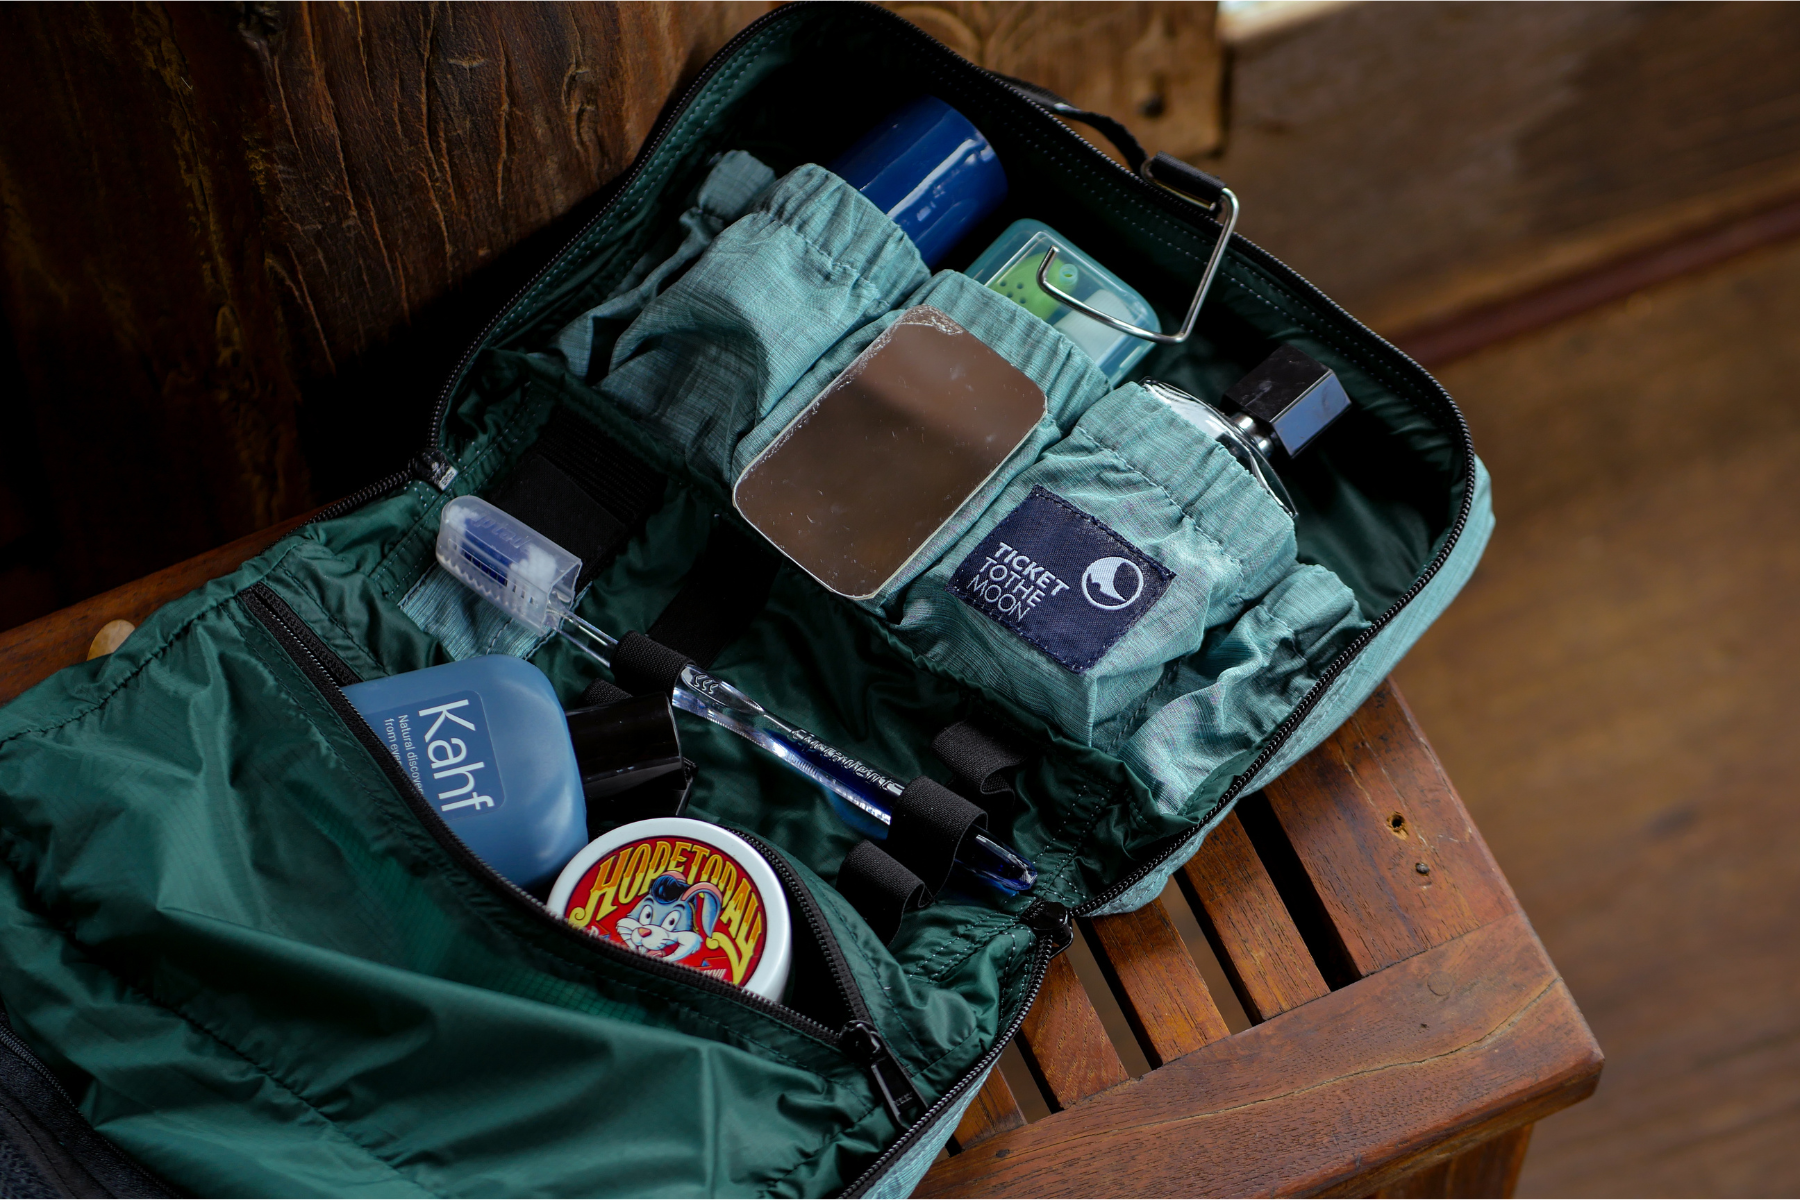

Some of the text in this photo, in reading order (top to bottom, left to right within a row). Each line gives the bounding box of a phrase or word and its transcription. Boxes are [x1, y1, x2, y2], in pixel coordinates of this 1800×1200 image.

[993, 542, 1070, 596] TICKET
[966, 573, 1031, 622] MOON
[384, 717, 399, 743] from
[398, 714, 417, 751] Natural
[418, 699, 495, 812] Kahf
